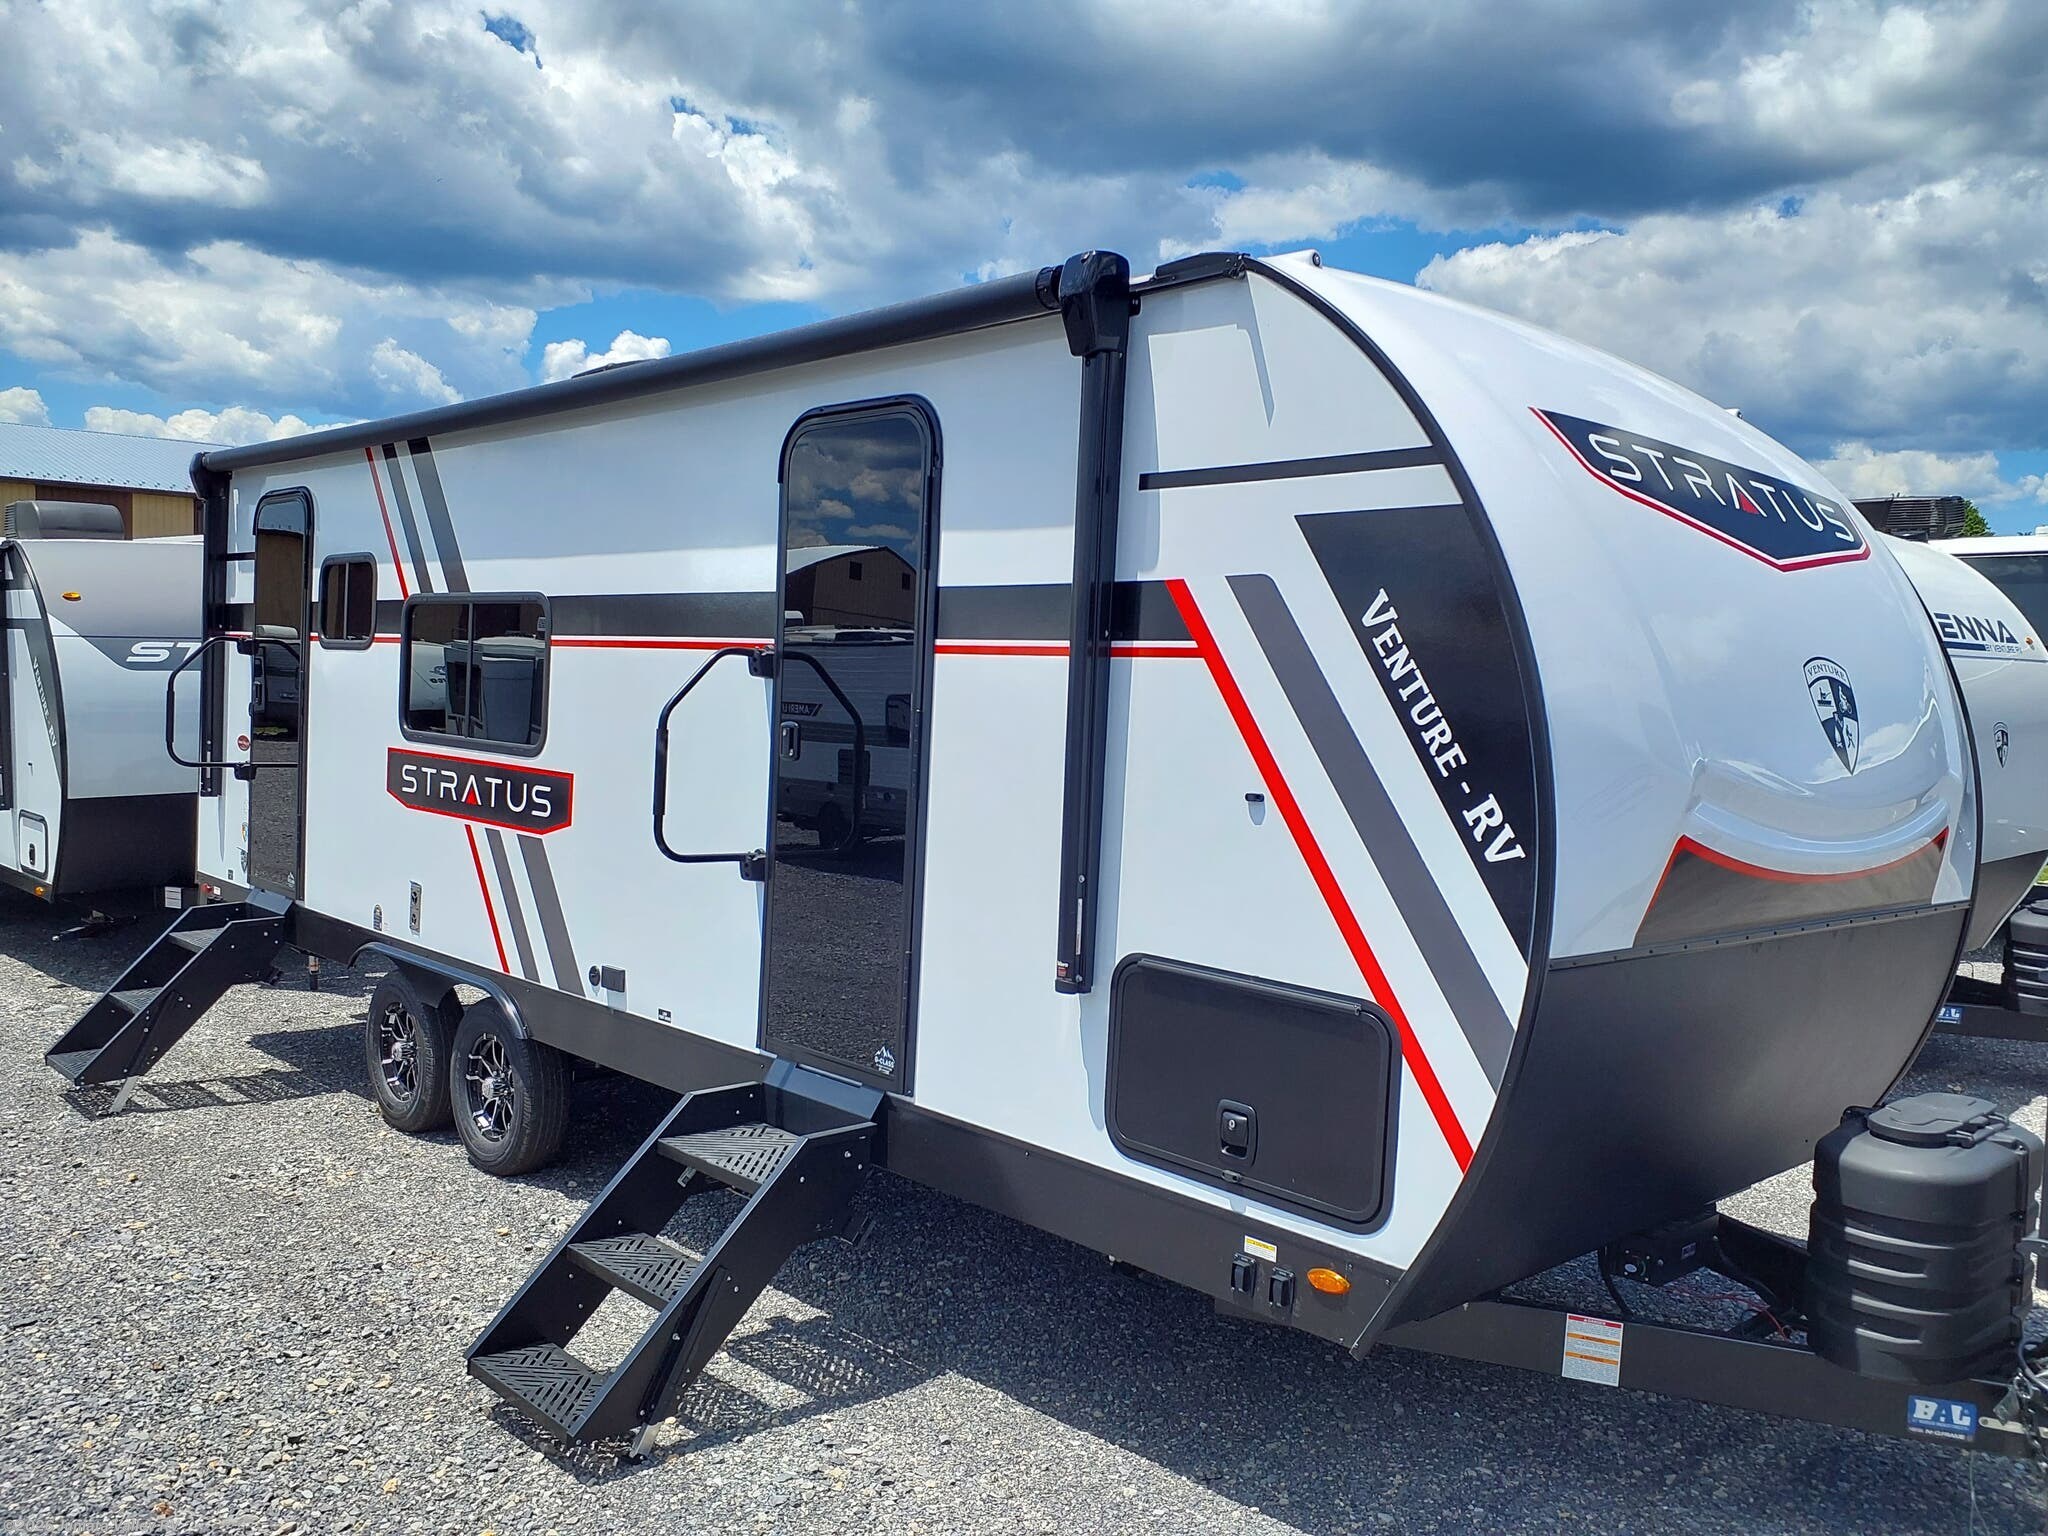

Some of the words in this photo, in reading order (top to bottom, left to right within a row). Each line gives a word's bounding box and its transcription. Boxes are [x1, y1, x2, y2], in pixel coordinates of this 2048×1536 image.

[1588, 432, 1856, 543] STRATUS
[1934, 612, 2020, 644] ENNA
[1361, 588, 1468, 778] VENTURE
[1462, 793, 1526, 863] RV
[401, 764, 552, 818] STRATUS
[1914, 1400, 1971, 1426] BAL
